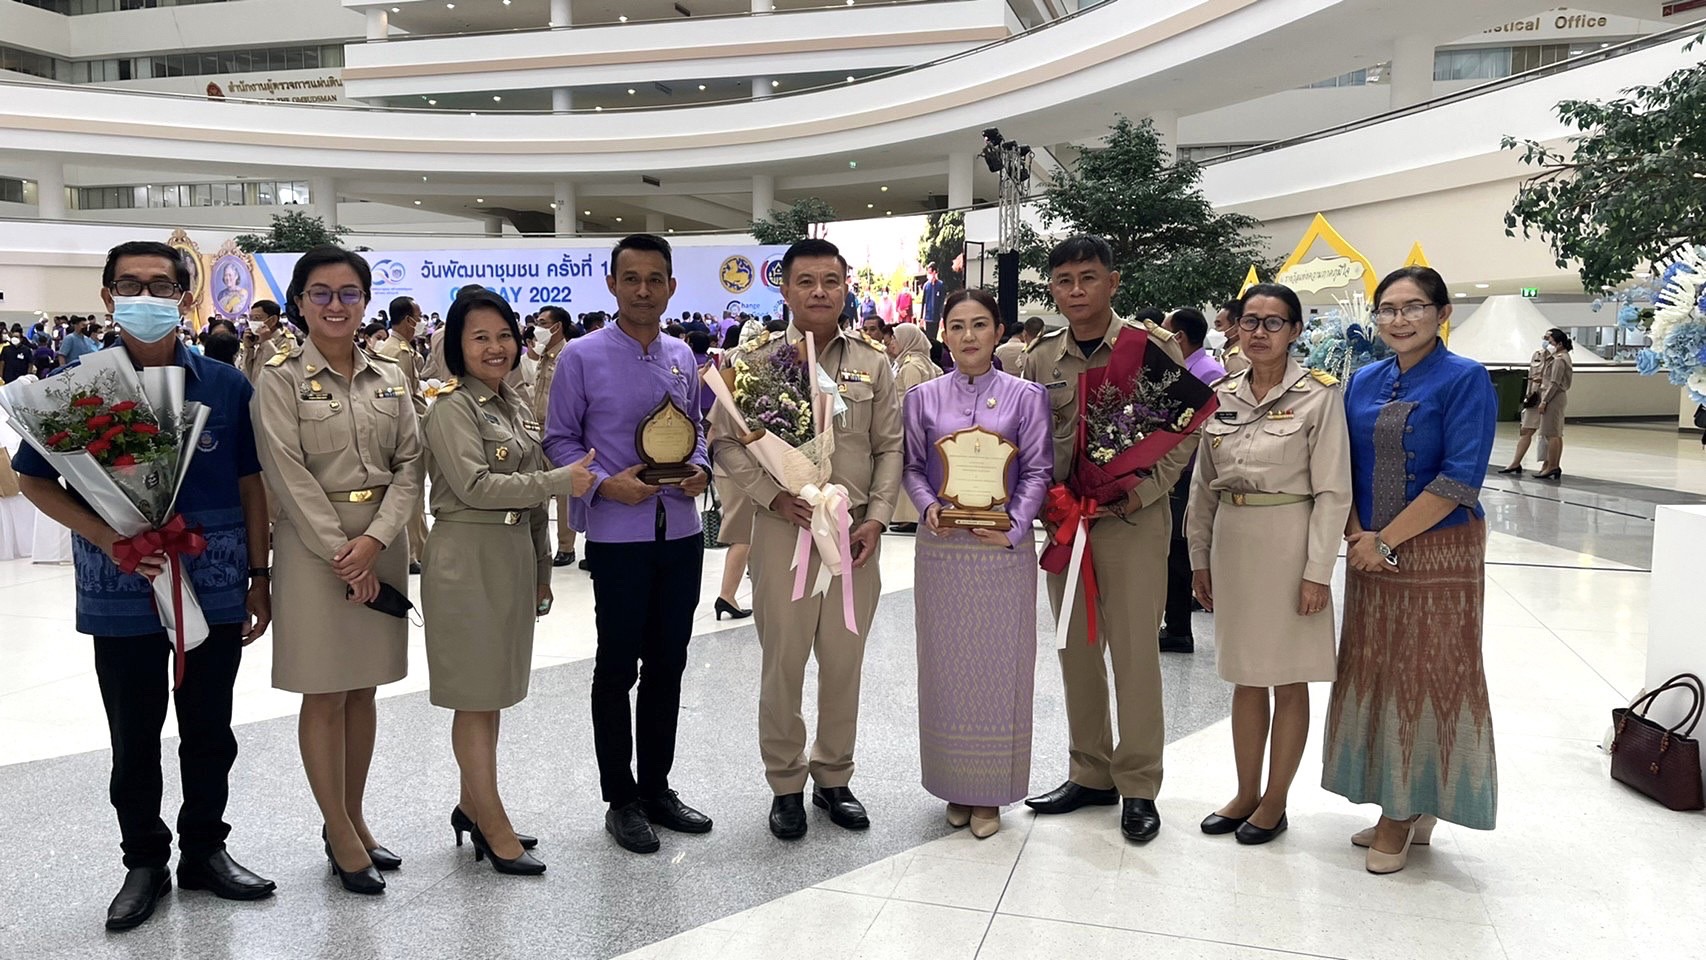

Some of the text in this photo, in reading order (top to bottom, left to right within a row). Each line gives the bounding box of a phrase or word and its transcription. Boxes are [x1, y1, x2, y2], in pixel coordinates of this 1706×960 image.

[1554, 14, 1607, 30] Office
[228, 76, 343, 94] สำนักงานผู้ตรวจการแผ่นดิน
[292, 94, 337, 103] OMBUDSMAN
[421, 259, 539, 282] วันพัฒนาชุมชน
[547, 253, 592, 277] ครั้งที่
[529, 286, 572, 303] 2022
